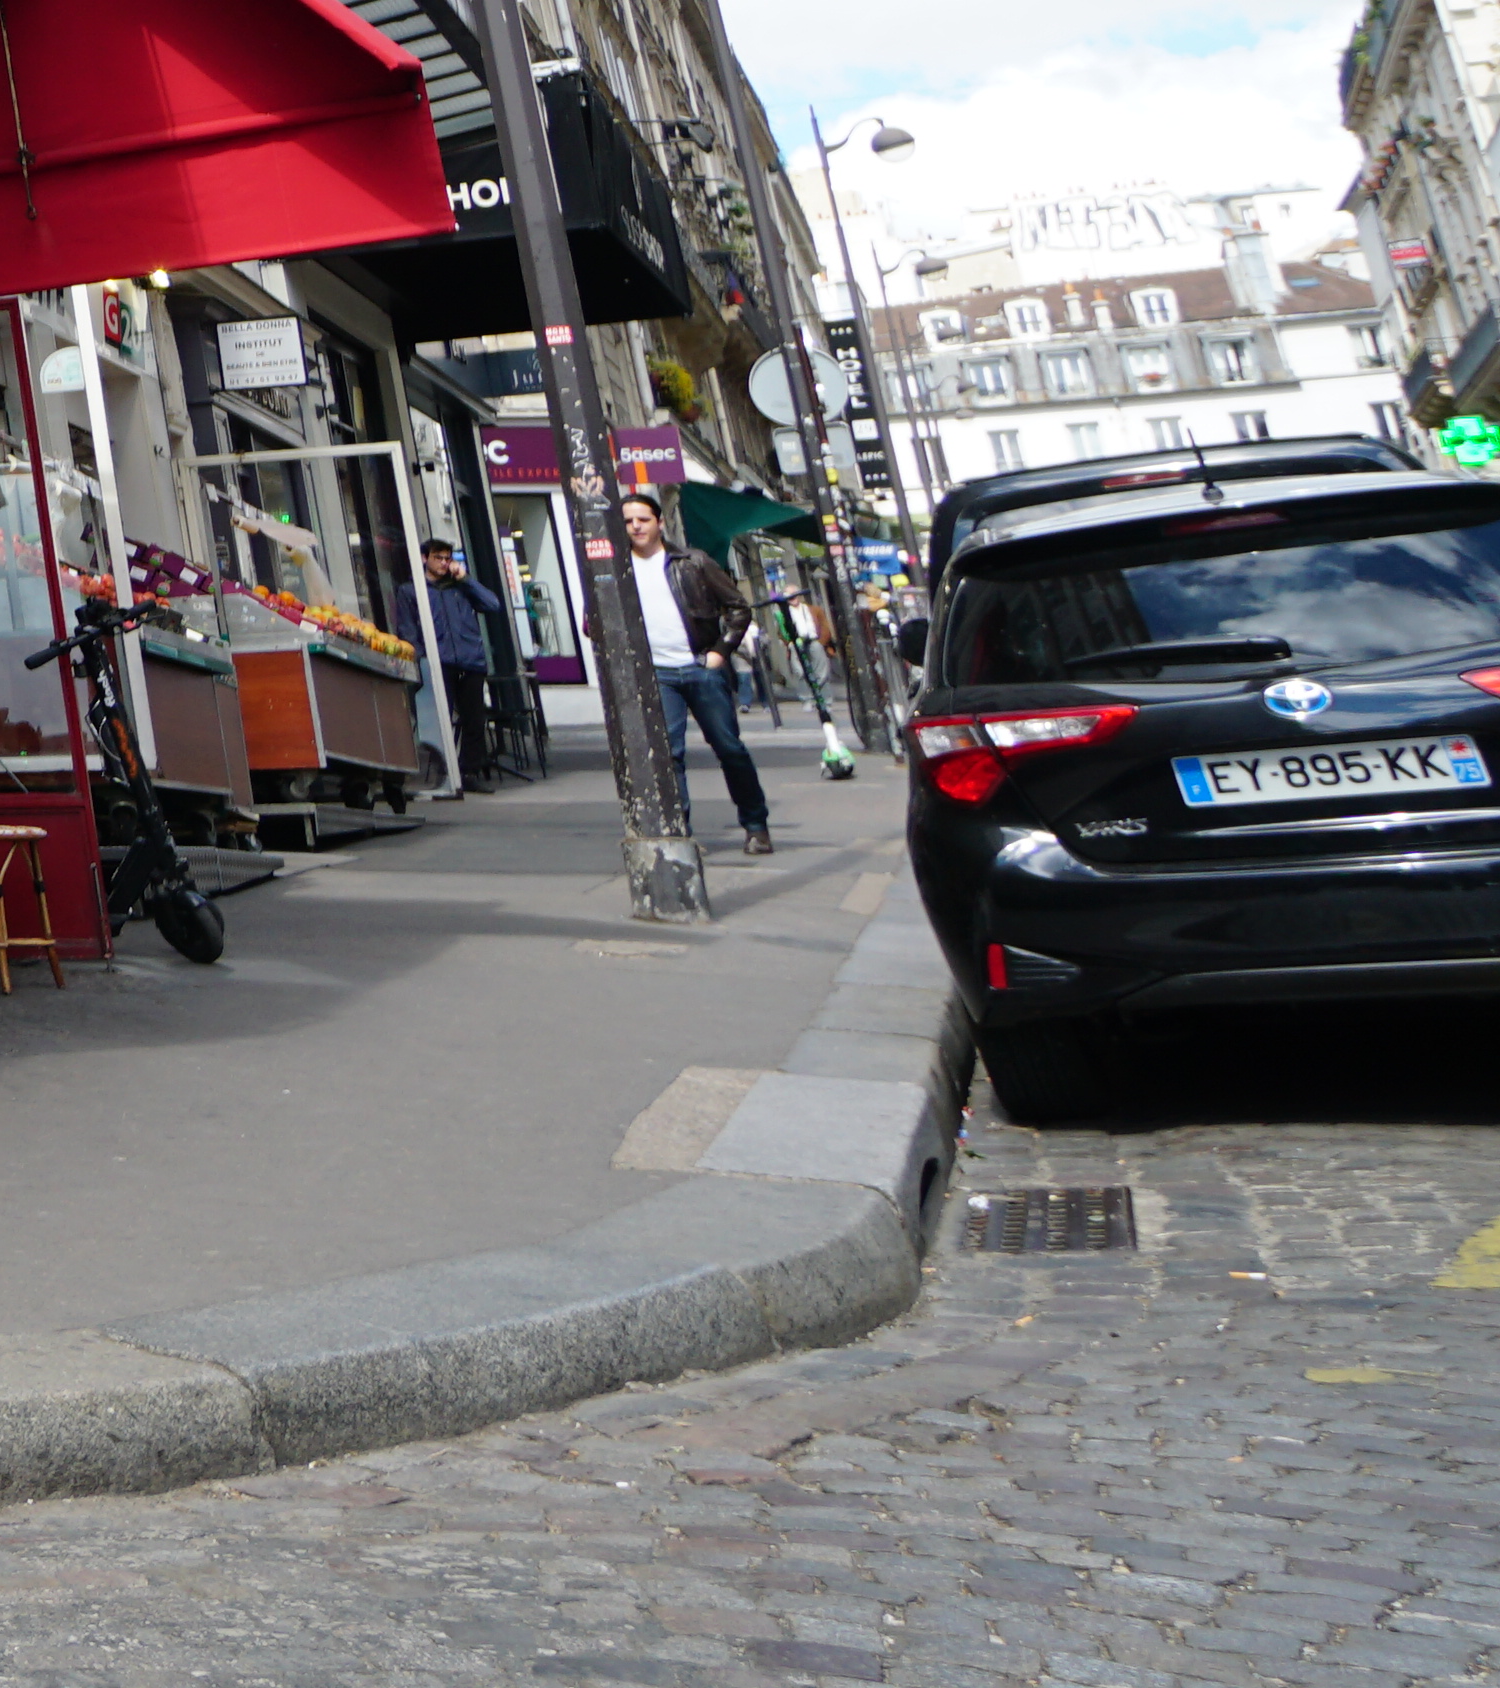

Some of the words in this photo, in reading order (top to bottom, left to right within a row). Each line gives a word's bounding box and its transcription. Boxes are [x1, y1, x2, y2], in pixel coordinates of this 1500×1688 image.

[221, 322, 253, 336] BELLA
[255, 319, 291, 331] DONNA
[234, 338, 283, 350] INSTITUT
[836, 347, 868, 409] HOTEL
[1207, 744, 1449, 794] EY-895-KK
[1454, 760, 1482, 782] 75
